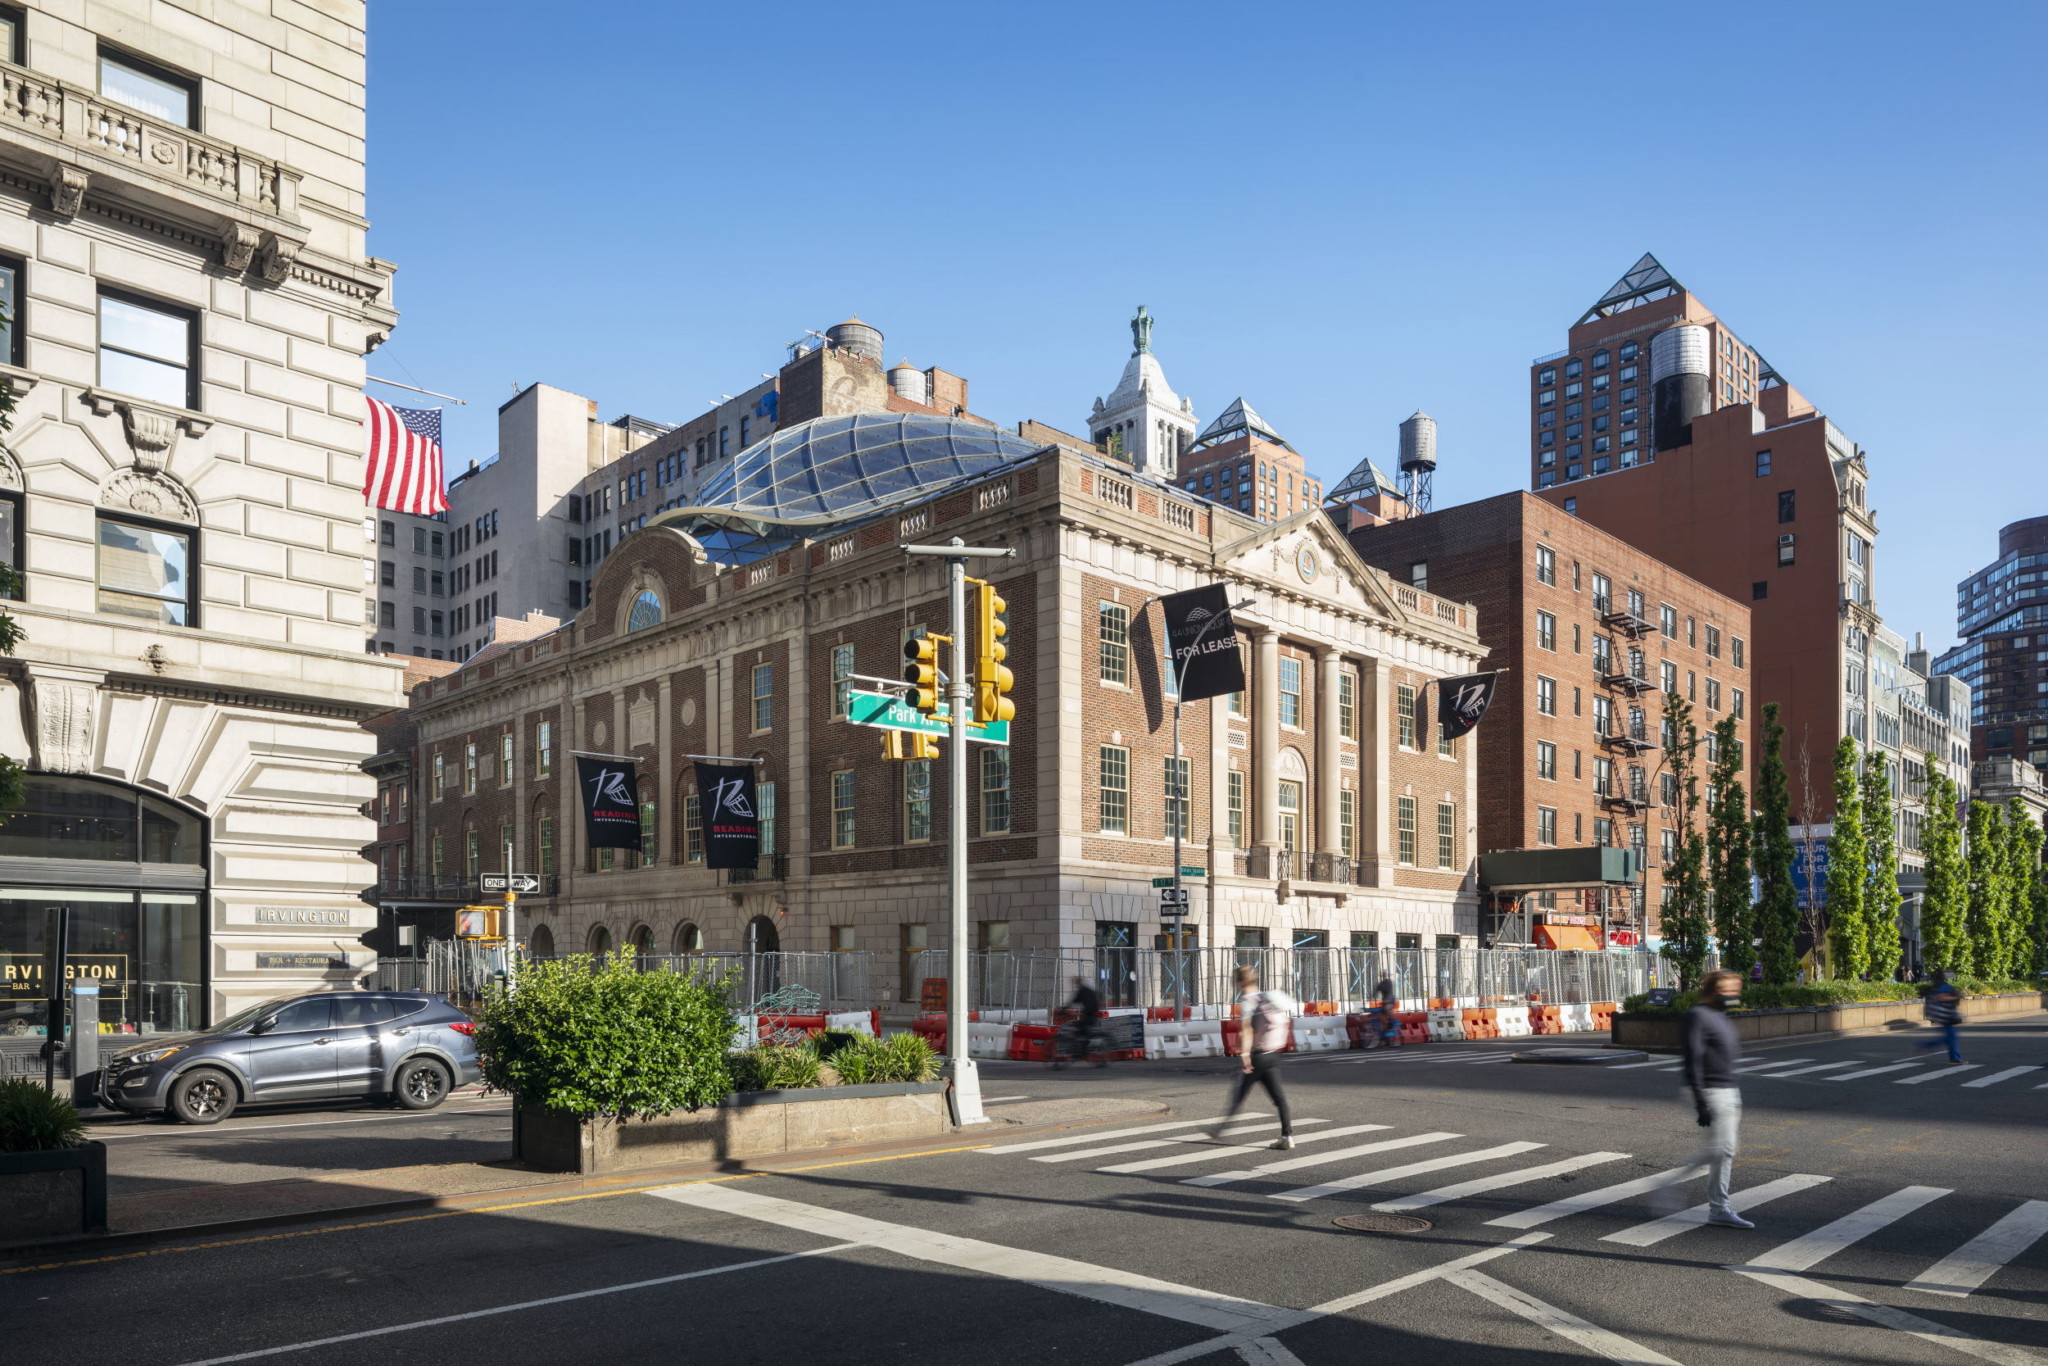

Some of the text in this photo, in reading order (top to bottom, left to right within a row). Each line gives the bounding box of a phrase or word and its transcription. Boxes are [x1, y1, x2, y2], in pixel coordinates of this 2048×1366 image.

[1176, 636, 1238, 659] FOR LEASE
[888, 704, 916, 724] Park
[593, 810, 637, 818] READING
[712, 825, 757, 833] READING
[1803, 854, 1824, 863] FOR
[258, 909, 348, 923] IRVINGTON
[5, 965, 117, 979] RVIGTON
[12, 982, 31, 990] BAR
